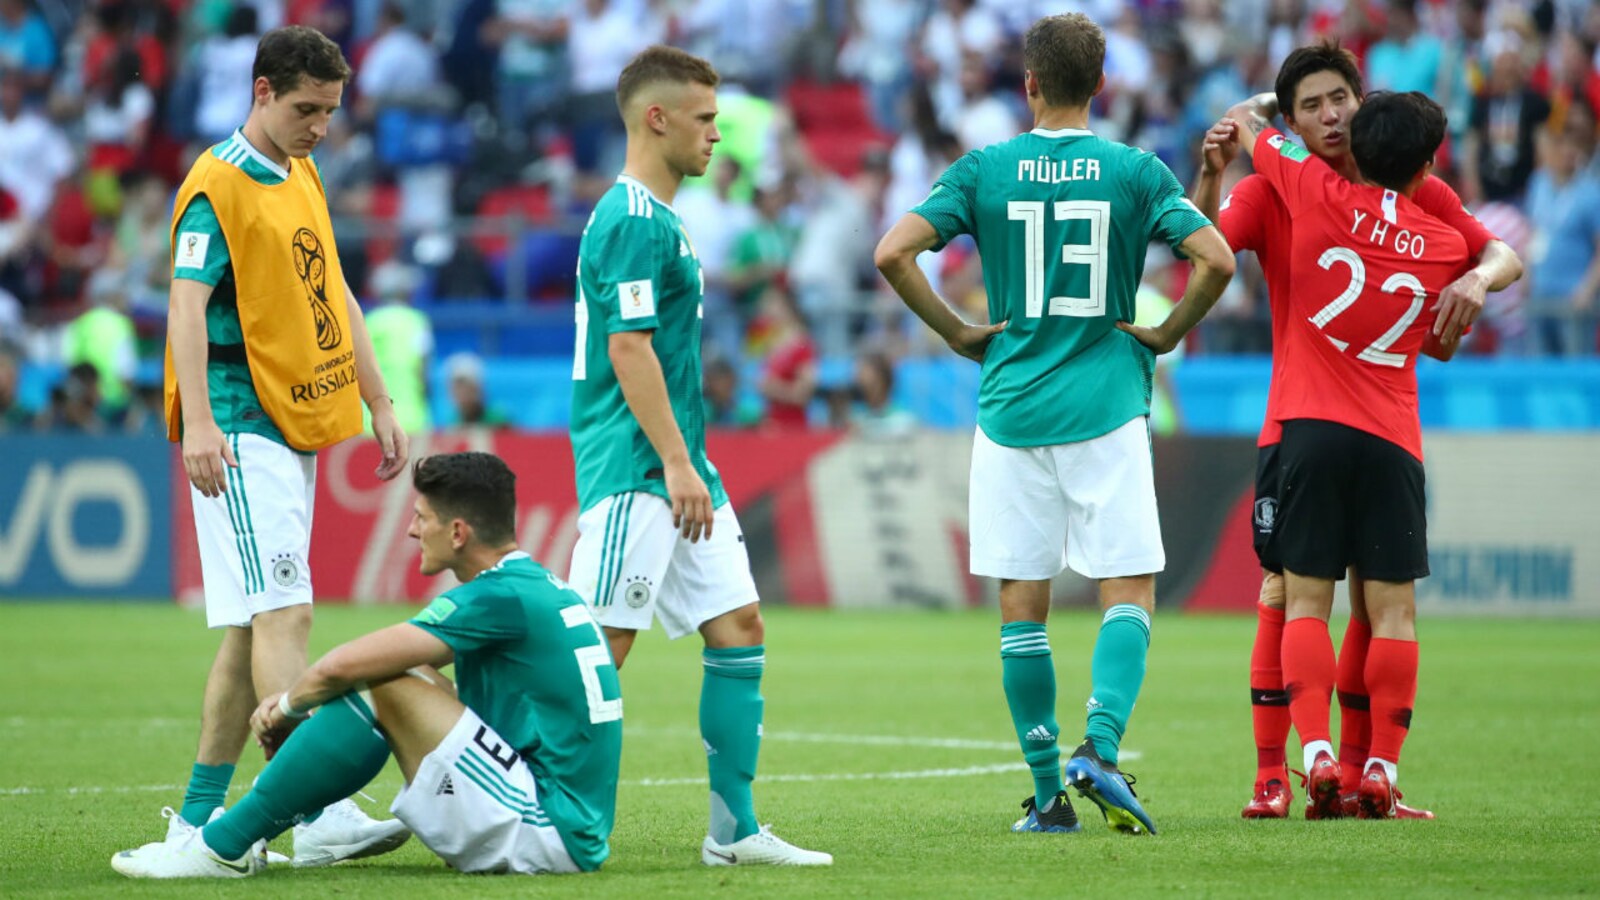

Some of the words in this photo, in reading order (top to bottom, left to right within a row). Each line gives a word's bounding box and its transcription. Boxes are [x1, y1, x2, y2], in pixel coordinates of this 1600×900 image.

[1017, 155, 1101, 184] MÜLLER
[1351, 208, 1367, 234] Y
[1369, 219, 1389, 246] H
[1394, 229, 1425, 259] GO
[1006, 200, 1111, 319] 13
[1307, 246, 1428, 369] 22
[290, 368, 350, 404] RUSSIA
